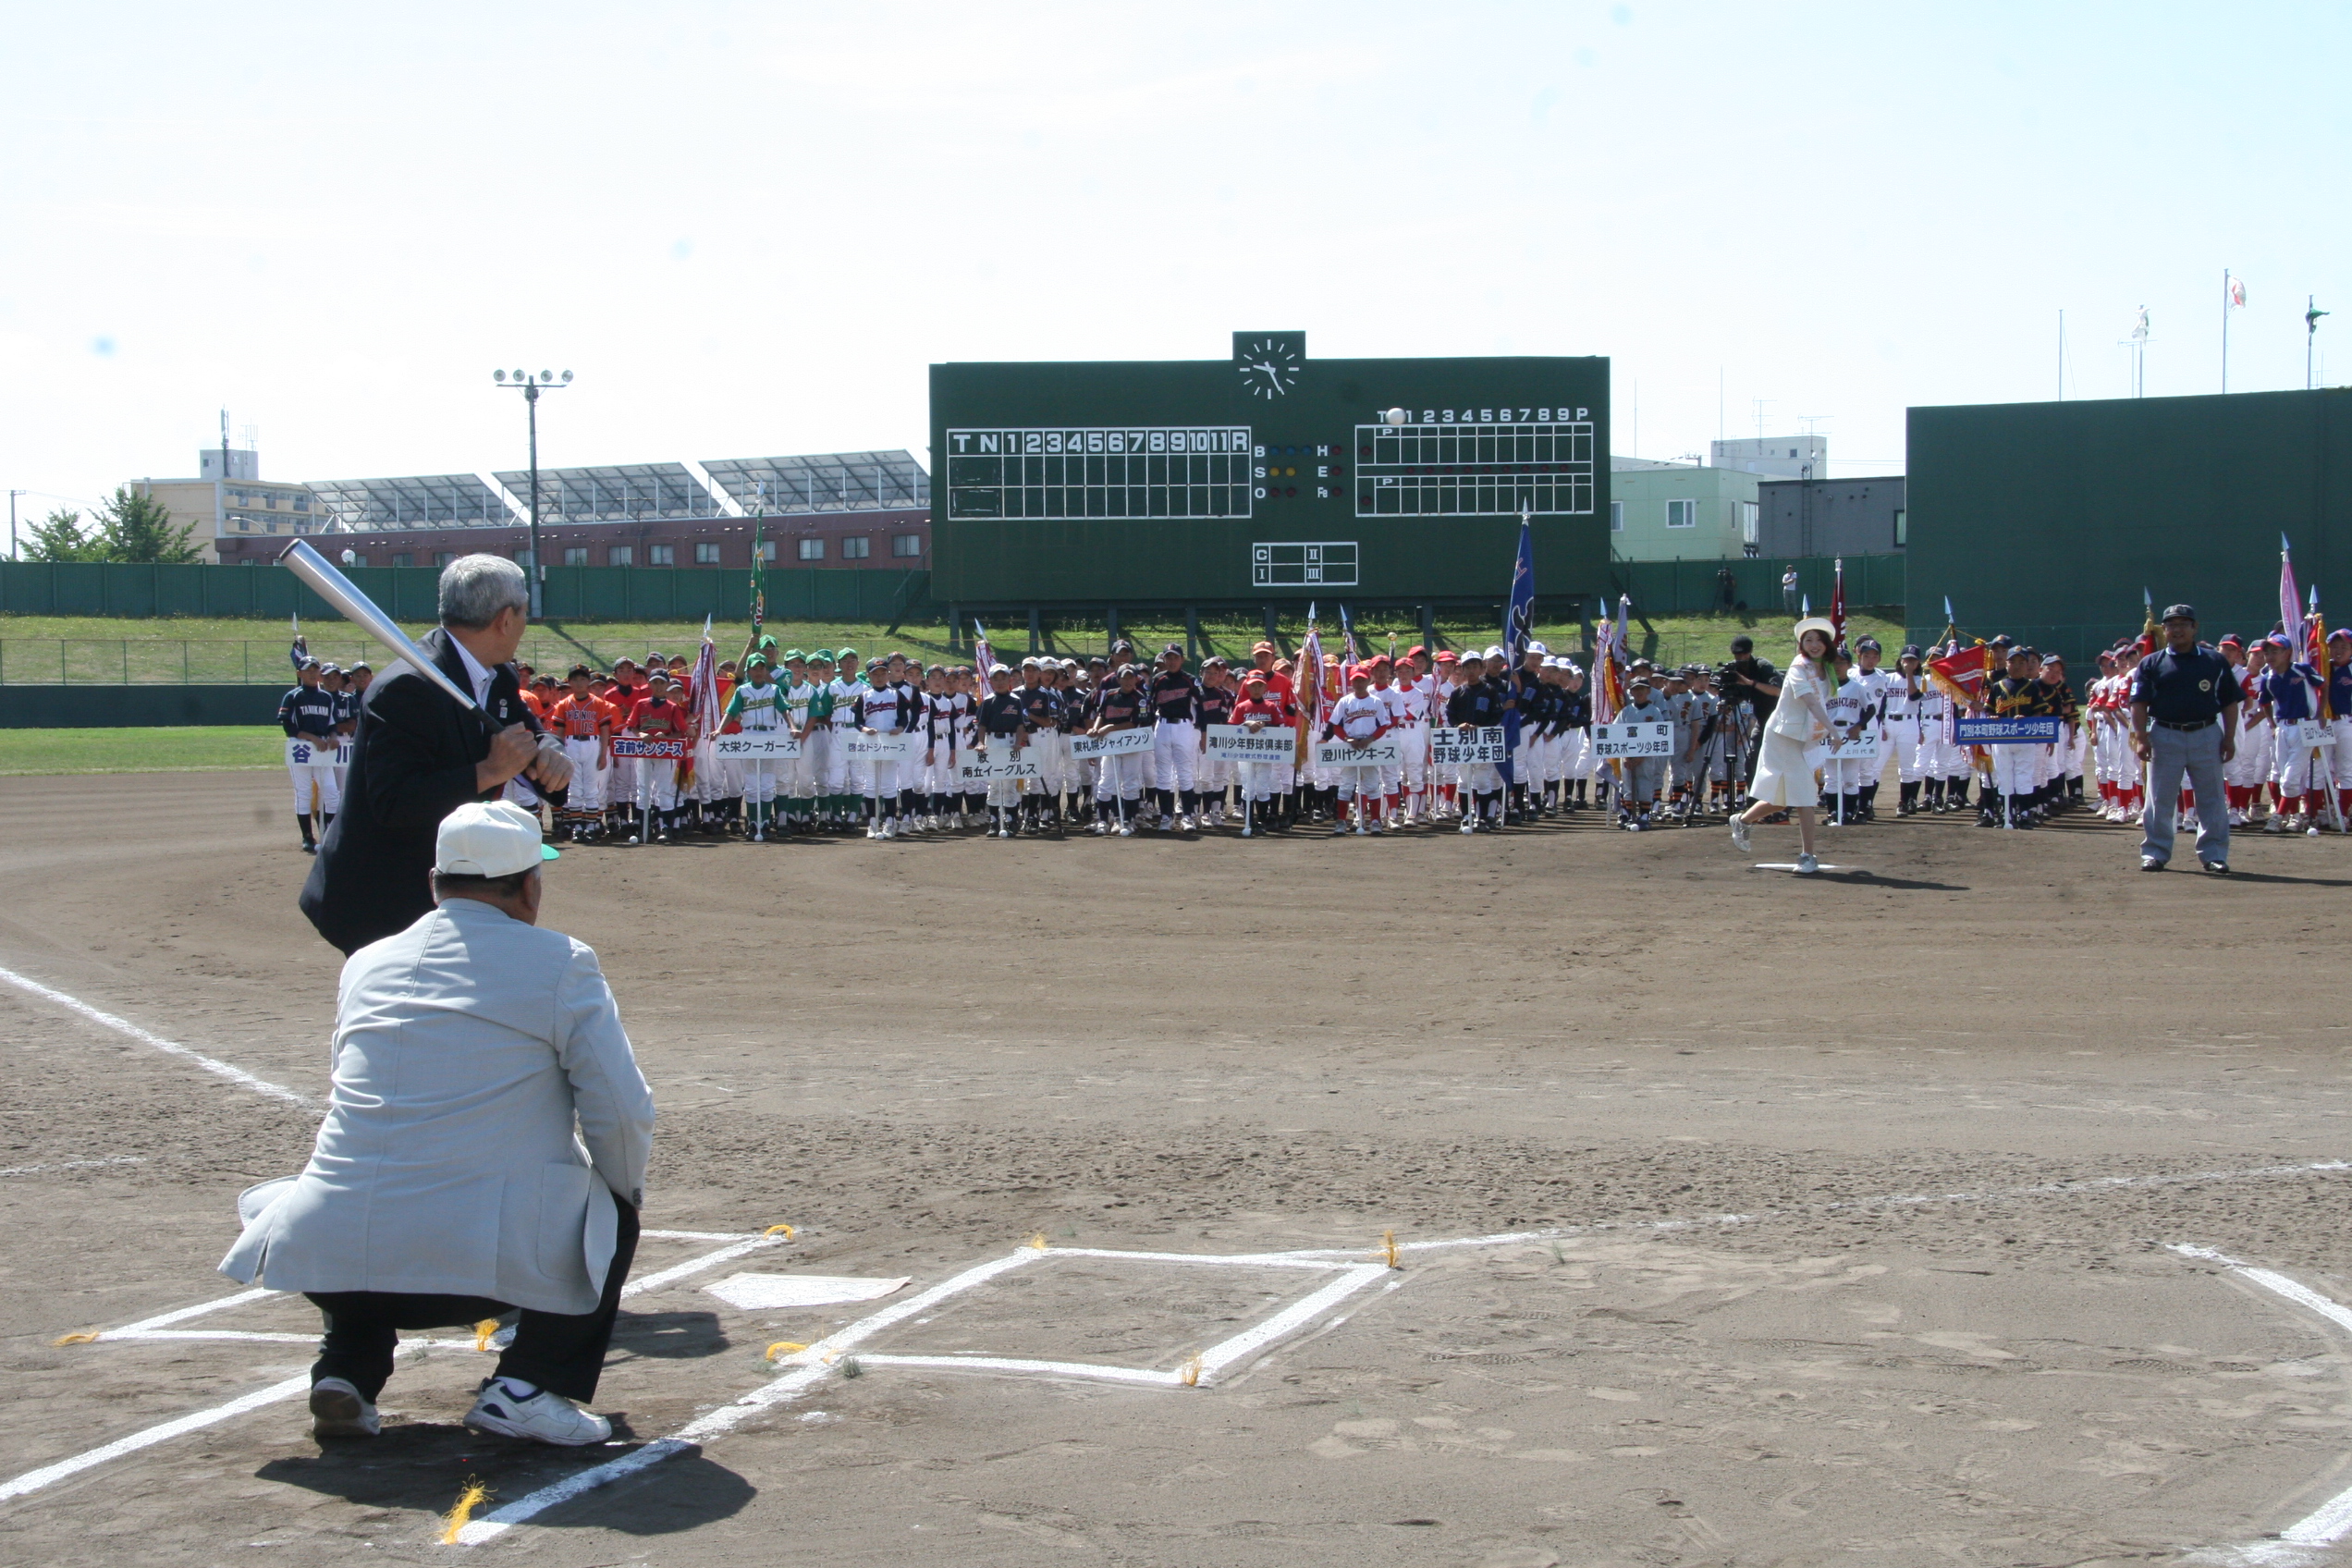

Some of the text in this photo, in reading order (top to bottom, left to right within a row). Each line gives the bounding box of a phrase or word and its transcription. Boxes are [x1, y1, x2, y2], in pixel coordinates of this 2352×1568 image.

[1405, 410, 1412, 423] 1
[1423, 410, 1435, 423] 2
[1442, 410, 1454, 423] 3
[1462, 410, 1473, 422] 4
[1480, 409, 1492, 422] 5
[1500, 409, 1512, 422] 6
[1519, 409, 1531, 422] 7
[1537, 408, 1550, 421] 8
[1557, 408, 1569, 421] 9
[1576, 408, 1588, 421] P
[1007, 434, 1015, 453] 1
[1026, 434, 1041, 452] 2
[1047, 434, 1061, 452] 3
[1067, 434, 1083, 452] 4
[1088, 433, 1103, 452] 5
[1109, 433, 1123, 451] 6
[1129, 434, 1144, 451] 7
[1150, 433, 1165, 451] 8
[1170, 433, 1185, 451] 9
[1190, 433, 1207, 451] 10
[1211, 432, 1227, 451] 11
[1232, 432, 1247, 450] R
[1255, 446, 1266, 458] B
[1317, 446, 1328, 457] H
[1255, 467, 1266, 478] S
[1317, 466, 1328, 477] E
[1255, 487, 1266, 499] O
[1256, 549, 1268, 560] C
[1597, 725, 1668, 739] 豊富町
[1959, 722, 2054, 737] 門別本町野球スポーツ少年団
[1433, 728, 1502, 746] 士別南
[718, 741, 798, 753] 大栄クーガーズ
[1596, 741, 1669, 755] 野球スポーツ少年団
[1321, 747, 1396, 762] 澄川ヤンキース
[1433, 746, 1503, 764] 野球少年団
[962, 764, 1037, 778] 南丘イーグルス
